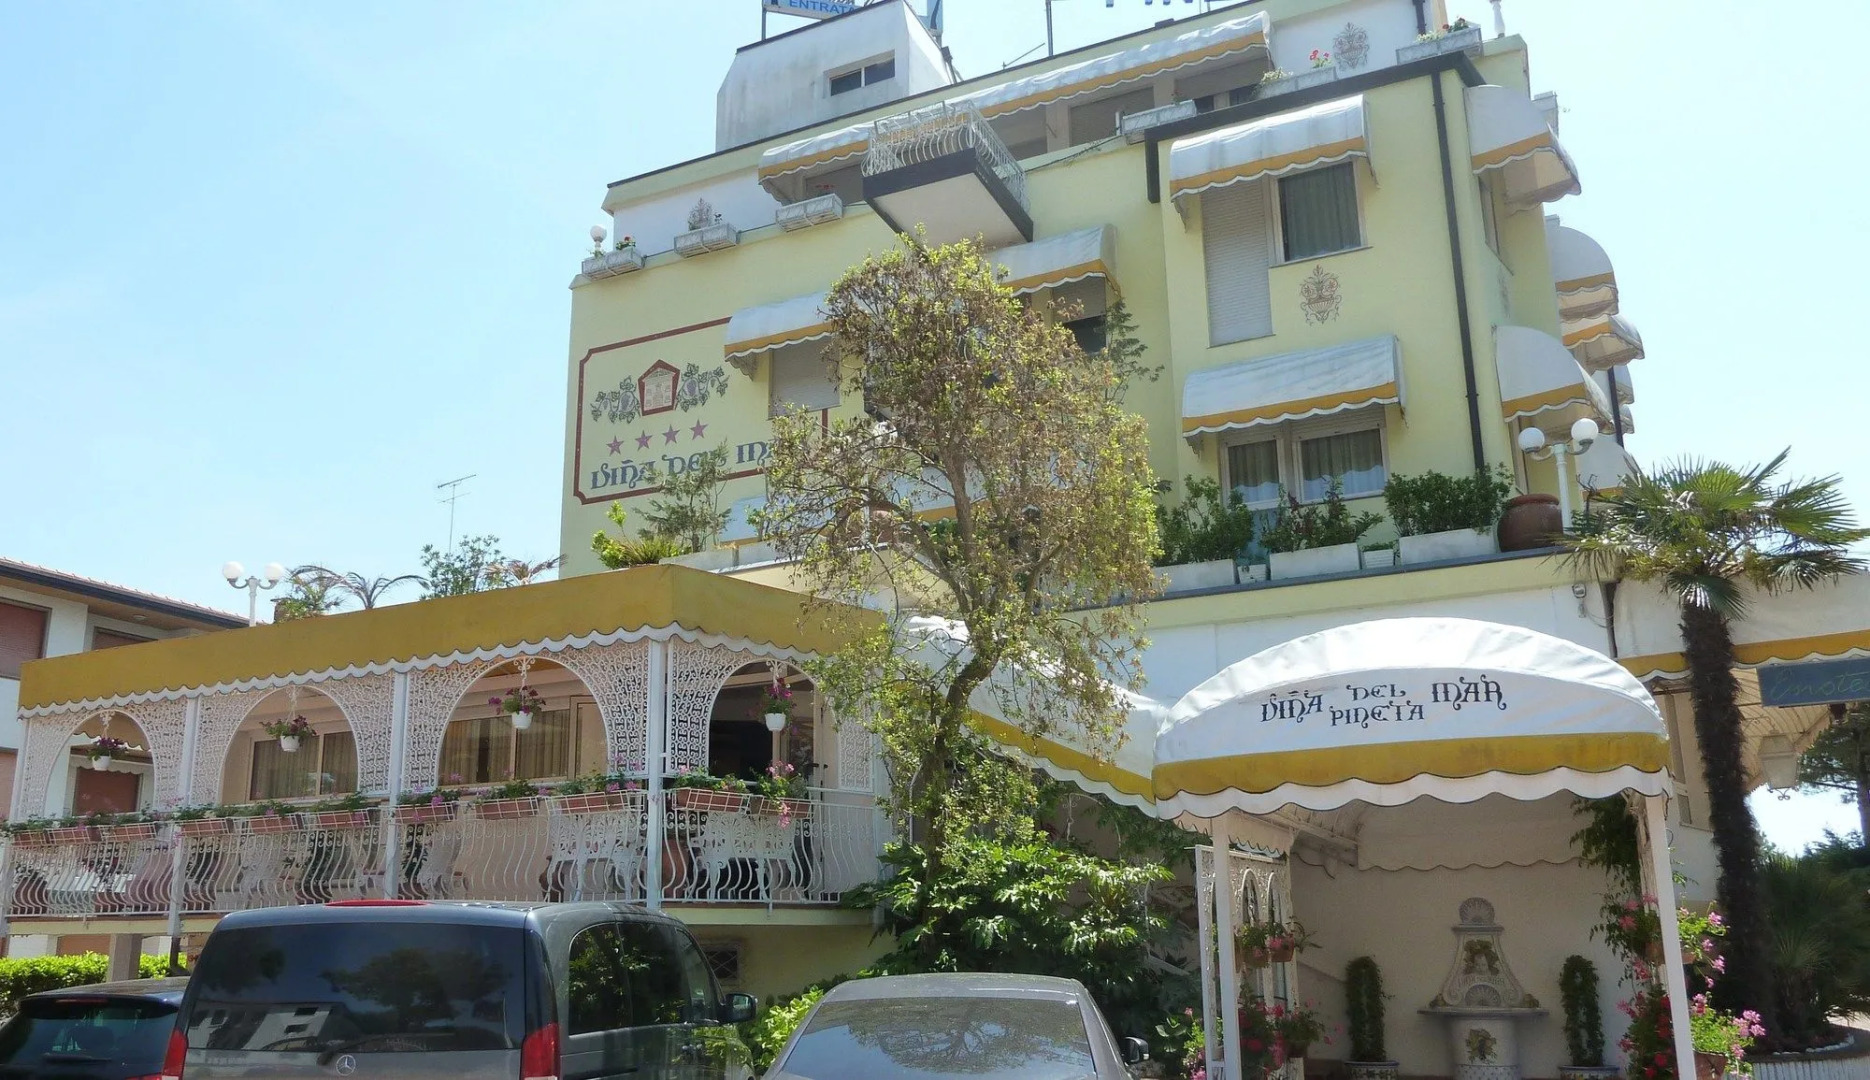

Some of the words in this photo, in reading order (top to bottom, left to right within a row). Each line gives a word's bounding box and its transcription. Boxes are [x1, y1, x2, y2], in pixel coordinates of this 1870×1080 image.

[1260, 690, 1323, 723] VIÑA
[1346, 684, 1406, 701] DEL
[1432, 674, 1507, 711] MAR
[1329, 700, 1425, 728] PINETA
